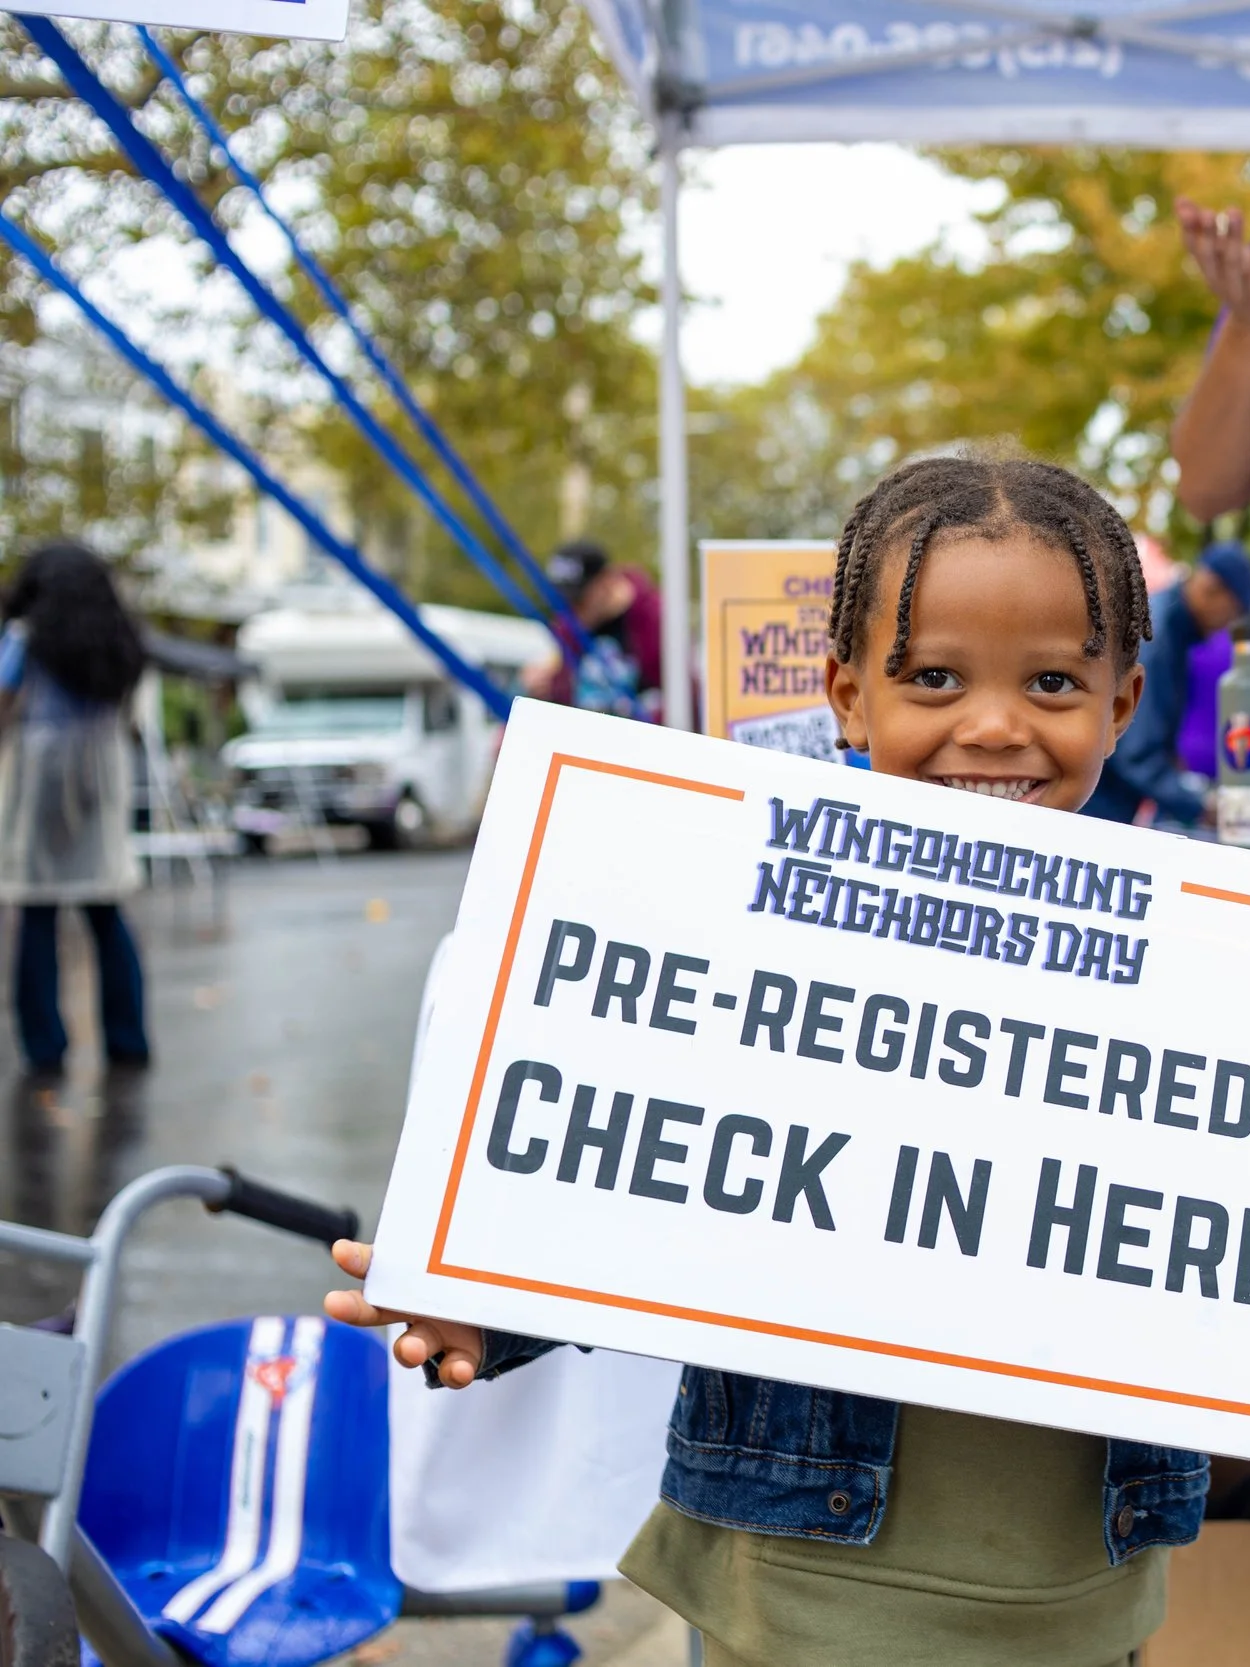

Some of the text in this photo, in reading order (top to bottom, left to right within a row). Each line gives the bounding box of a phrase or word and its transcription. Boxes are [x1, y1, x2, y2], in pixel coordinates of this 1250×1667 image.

[748, 857, 1149, 984] NEIGHBORS DAY
[766, 797, 1152, 920] WINGOHOCKING
[486, 1060, 852, 1231] CHECK
[884, 1145, 992, 1257] IN
